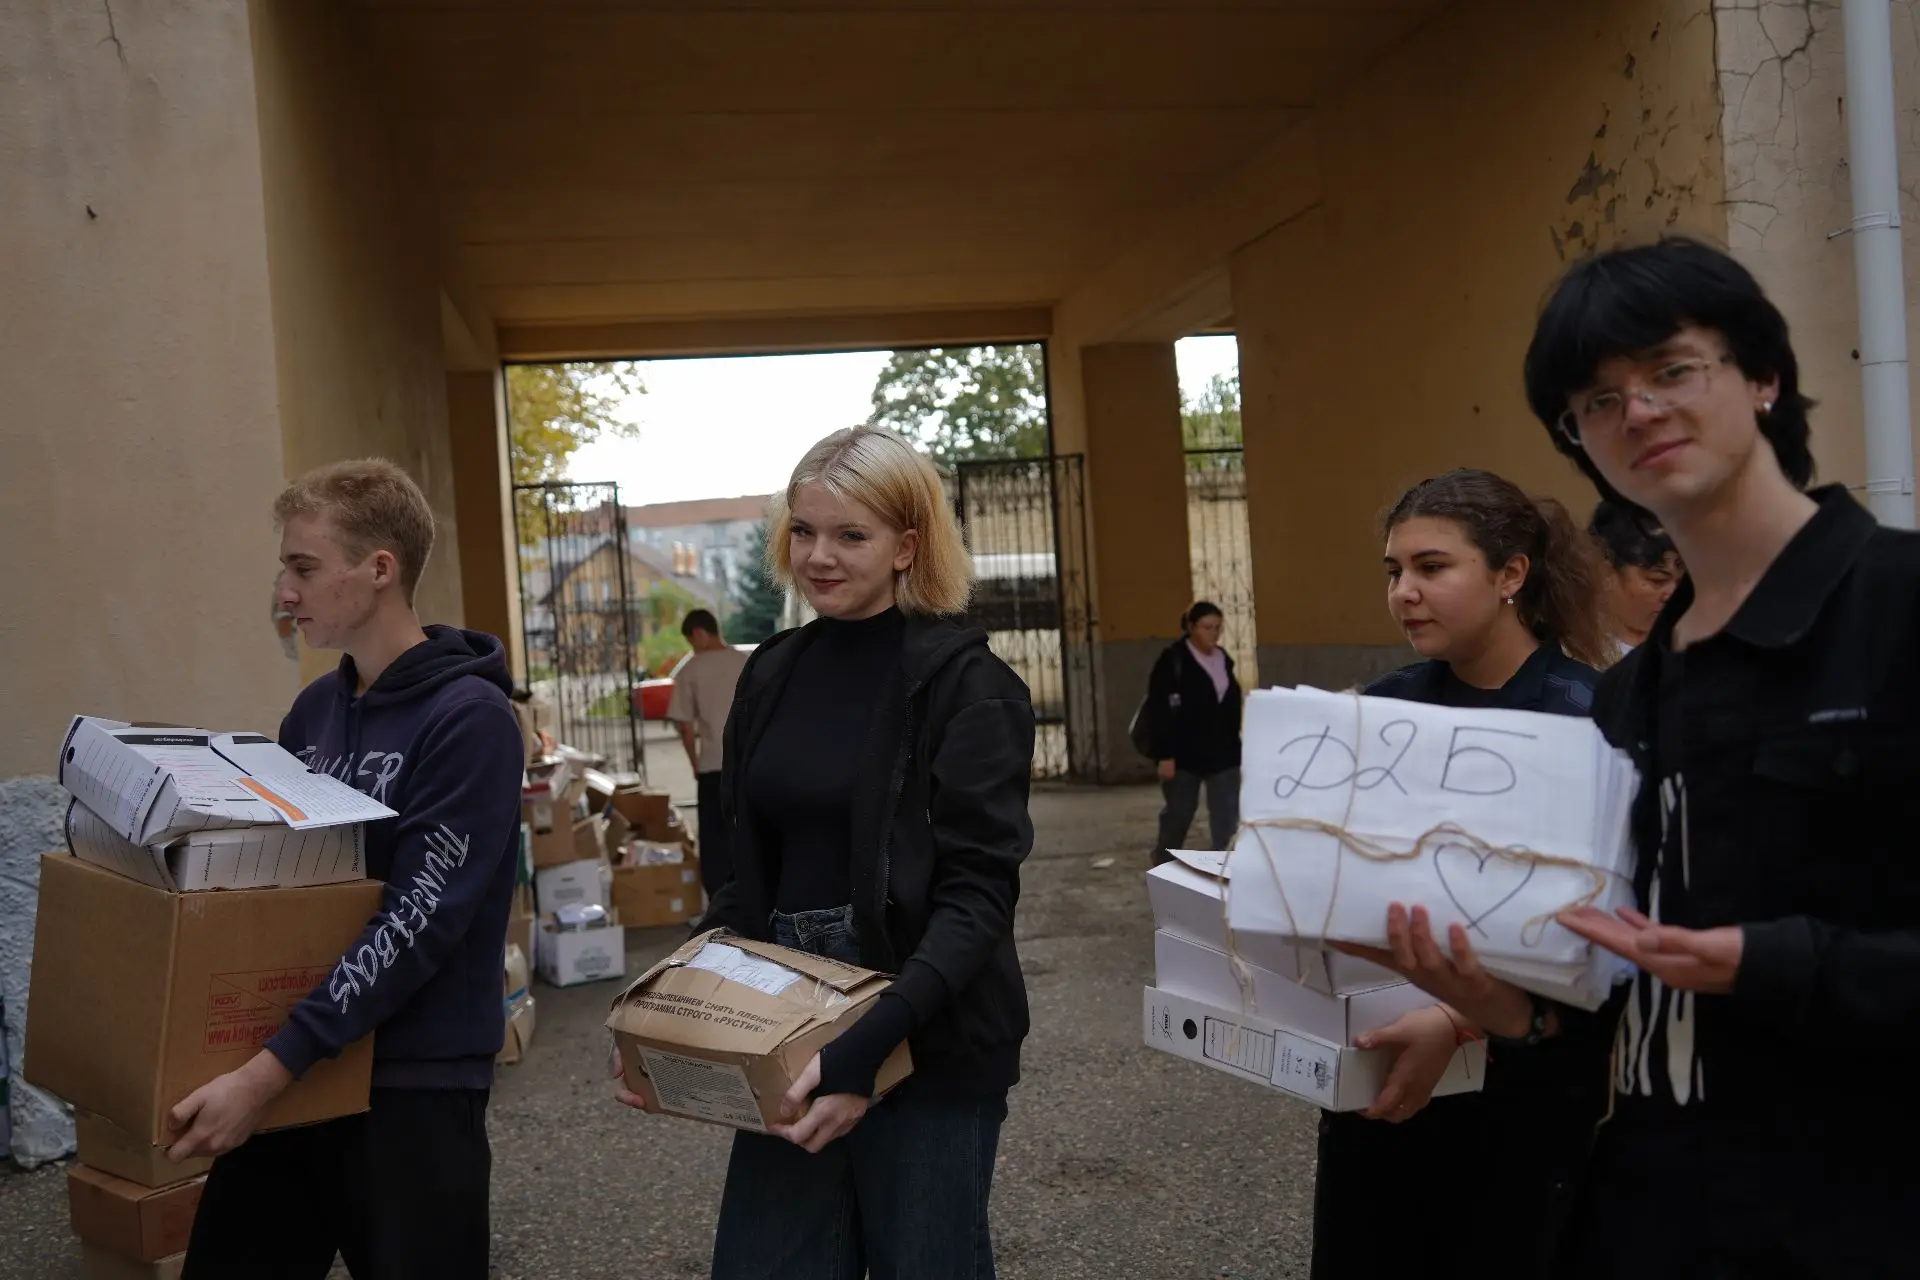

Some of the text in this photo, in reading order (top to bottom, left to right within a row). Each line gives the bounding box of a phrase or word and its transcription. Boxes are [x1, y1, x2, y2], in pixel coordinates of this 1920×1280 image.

[633, 1000, 766, 1033] ПРОГРАММА СТРОГО «РУСТИК»
[655, 992, 704, 1007] ВЫПЕКАНИЕМ
[704, 1002, 735, 1015] СНЯТЬ
